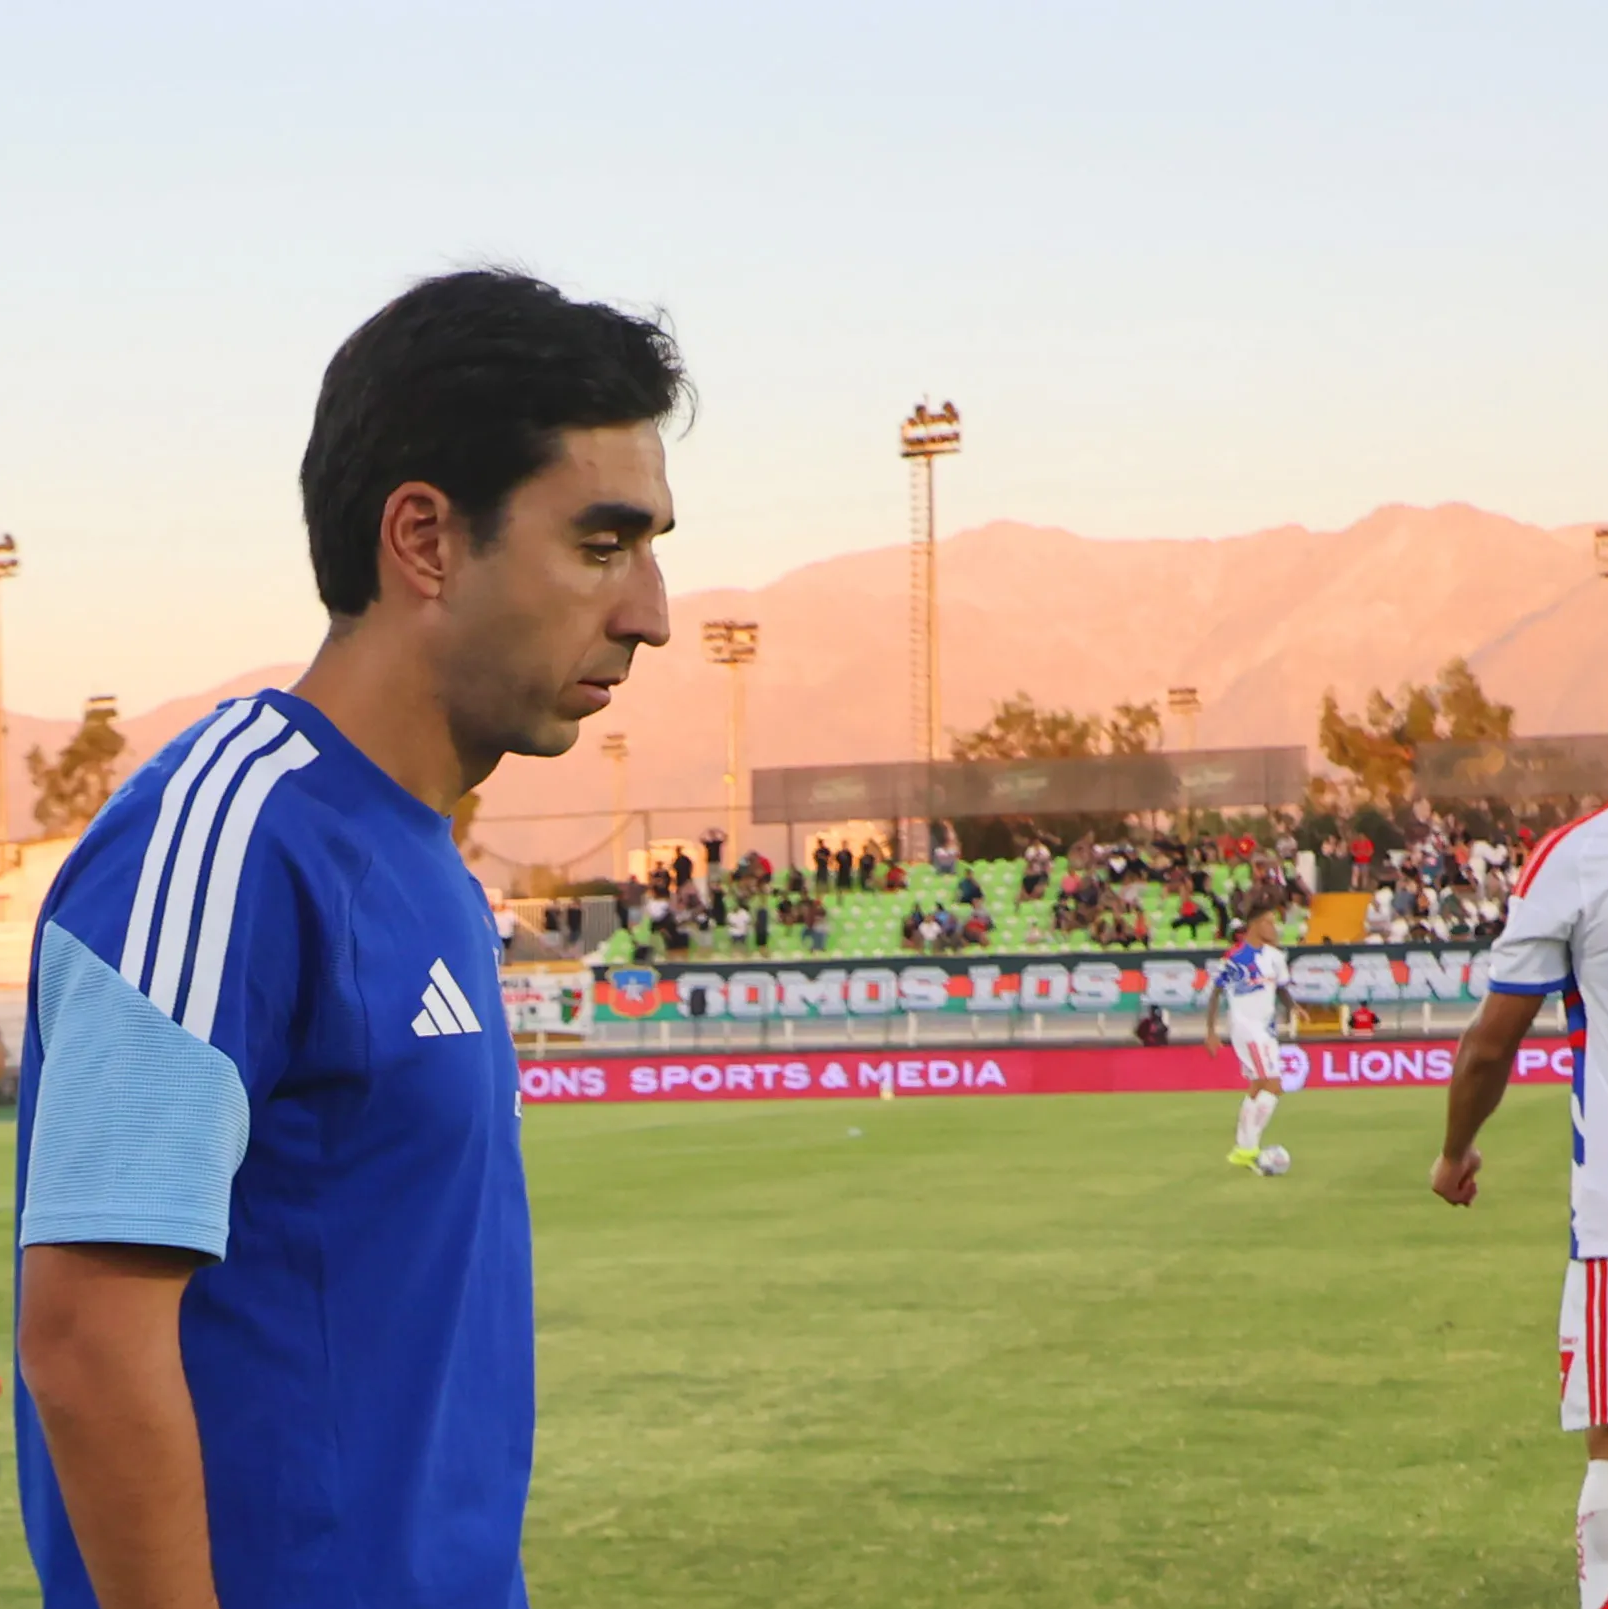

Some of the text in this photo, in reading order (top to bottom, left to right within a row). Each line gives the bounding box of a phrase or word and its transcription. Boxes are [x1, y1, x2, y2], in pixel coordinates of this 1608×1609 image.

[676, 965, 951, 1019] SOMOS
[965, 961, 1123, 1013] LOS
[521, 1060, 1007, 1097] ONS SPORTS & MEDIA
[1323, 1048, 1454, 1082] LIONS
